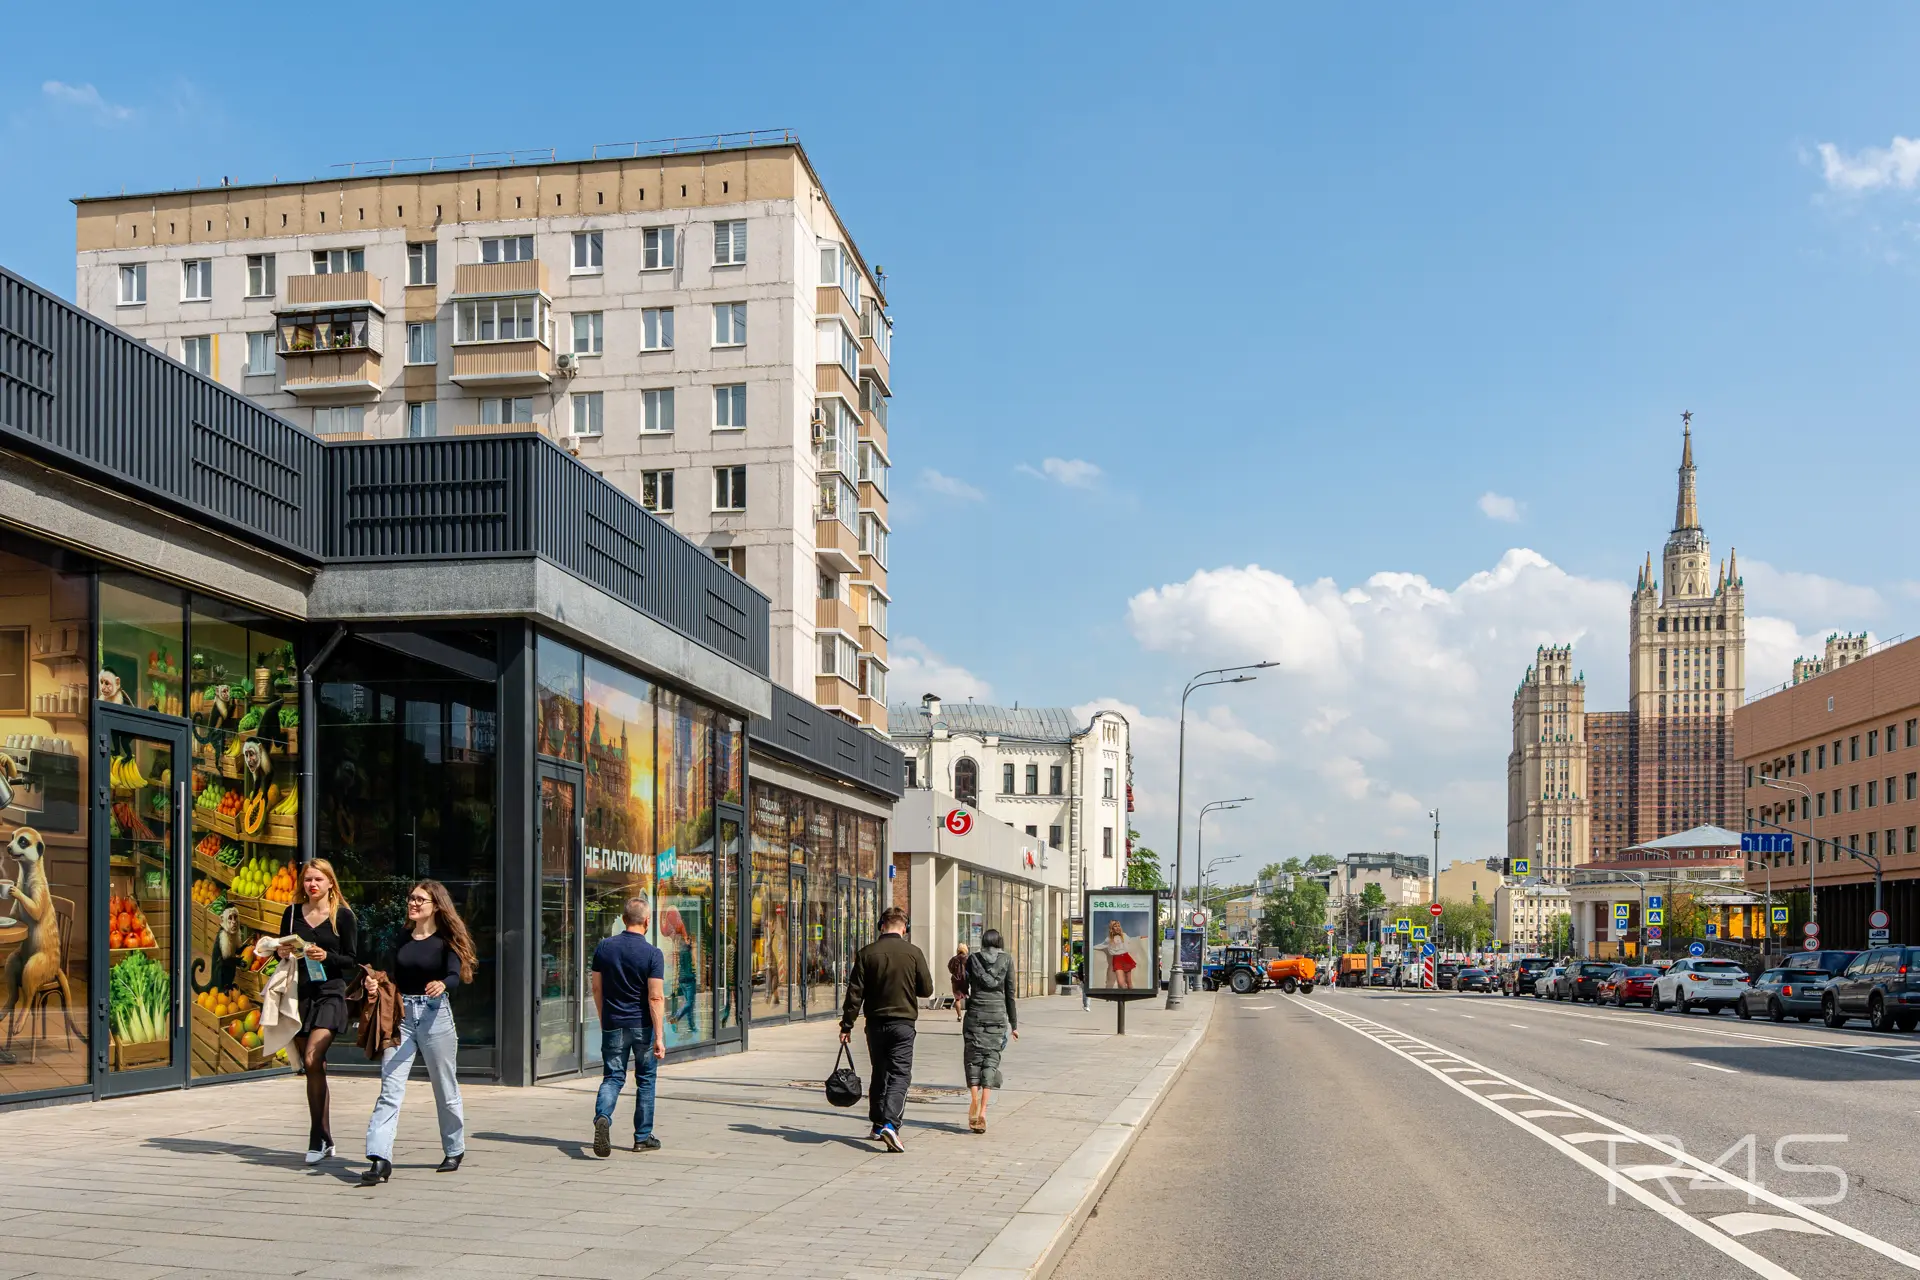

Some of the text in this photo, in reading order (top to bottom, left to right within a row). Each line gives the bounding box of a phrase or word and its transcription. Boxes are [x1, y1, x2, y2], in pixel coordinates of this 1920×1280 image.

[951, 811, 967, 831] 5
[585, 846, 652, 875] НЕ ПАТРИКИ
[660, 853, 675, 876] but
[676, 858, 710, 881] ПРЕСНЯ
[1618, 920, 1626, 929] P
[1708, 925, 1715, 933] P
[1806, 940, 1816, 948] 40
